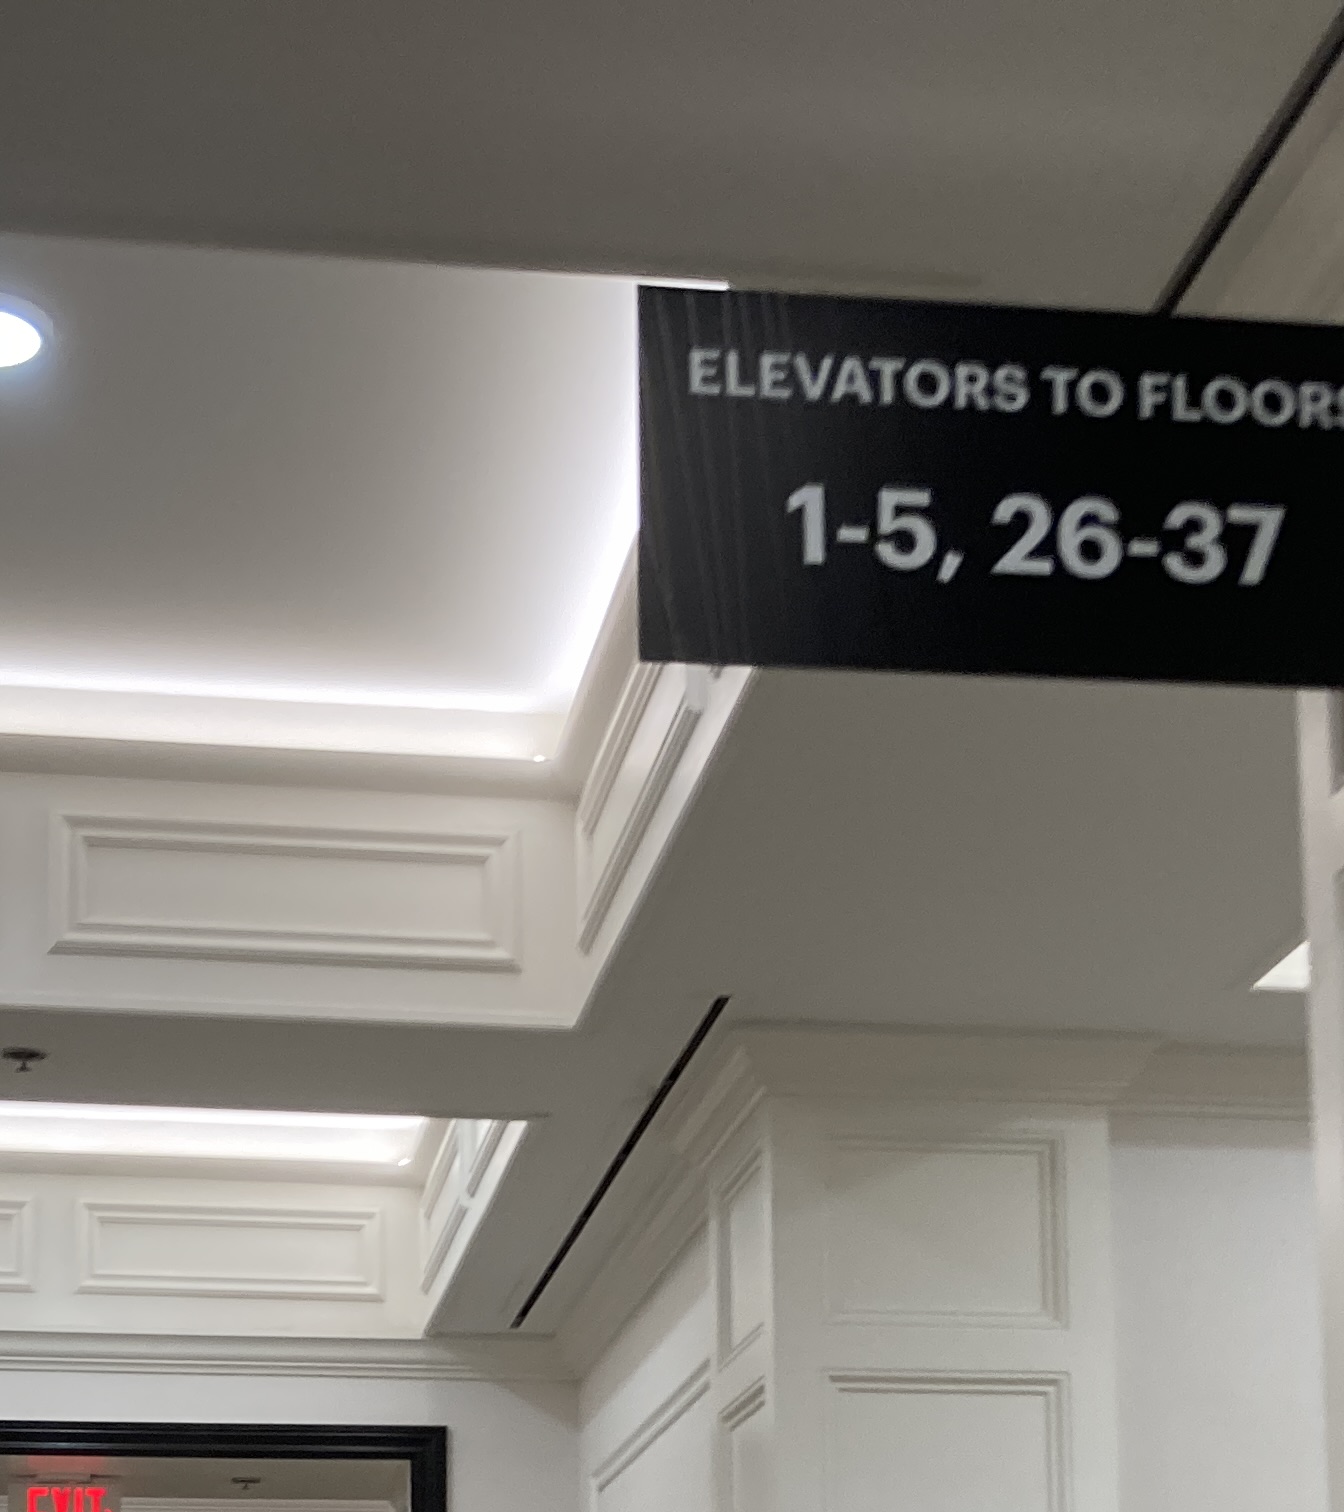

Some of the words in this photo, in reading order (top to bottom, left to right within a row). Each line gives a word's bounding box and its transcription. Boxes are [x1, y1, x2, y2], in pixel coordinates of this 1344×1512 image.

[687, 346, 1030, 414] ELEVATORS
[1041, 365, 1126, 419] TO
[784, 482, 964, 585] 1-5,
[989, 492, 1288, 589] 26-37
